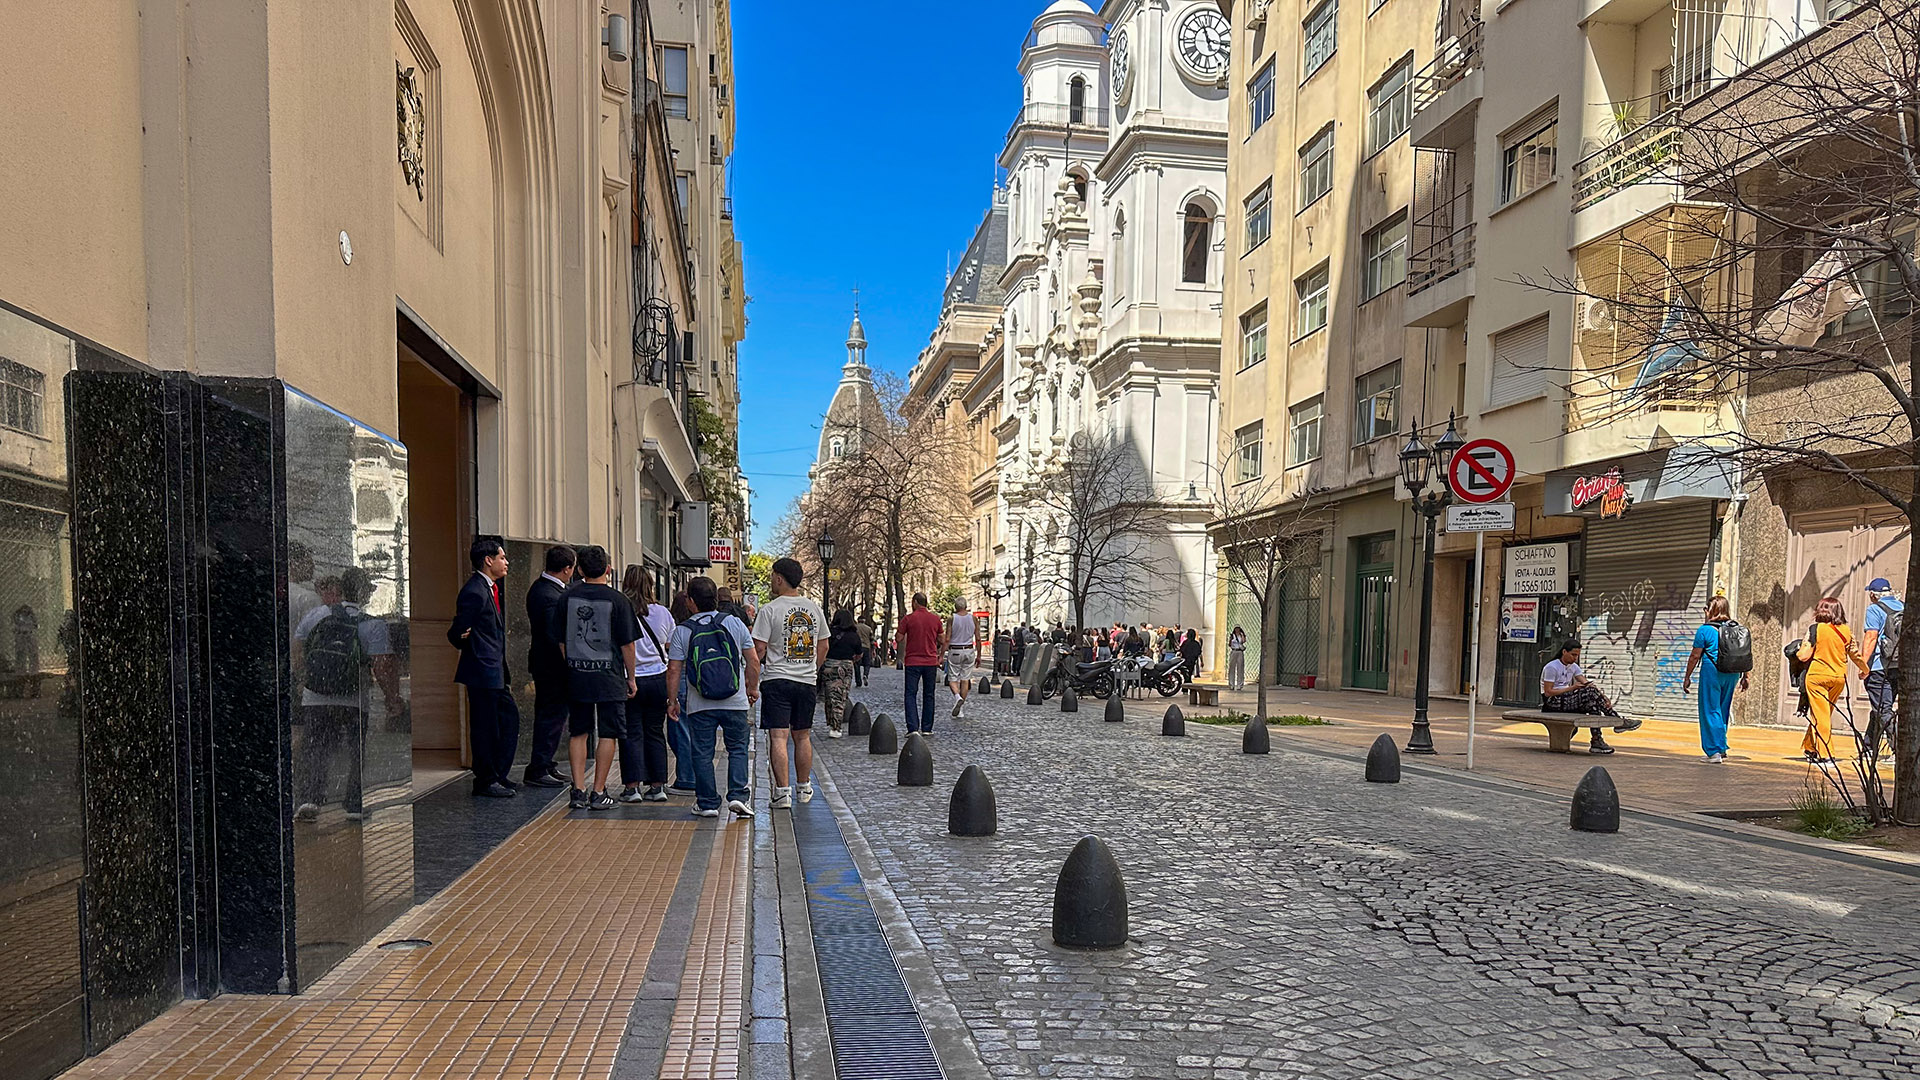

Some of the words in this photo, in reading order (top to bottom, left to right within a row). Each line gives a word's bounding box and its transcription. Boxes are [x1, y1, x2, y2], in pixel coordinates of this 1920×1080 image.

[1608, 484, 1625, 501] HAM
[1601, 494, 1626, 519] Cheese
[1514, 547, 1556, 560] SCHIAFFINO
[1540, 579, 1556, 591] 1031
[568, 660, 612, 669] REVIVE
